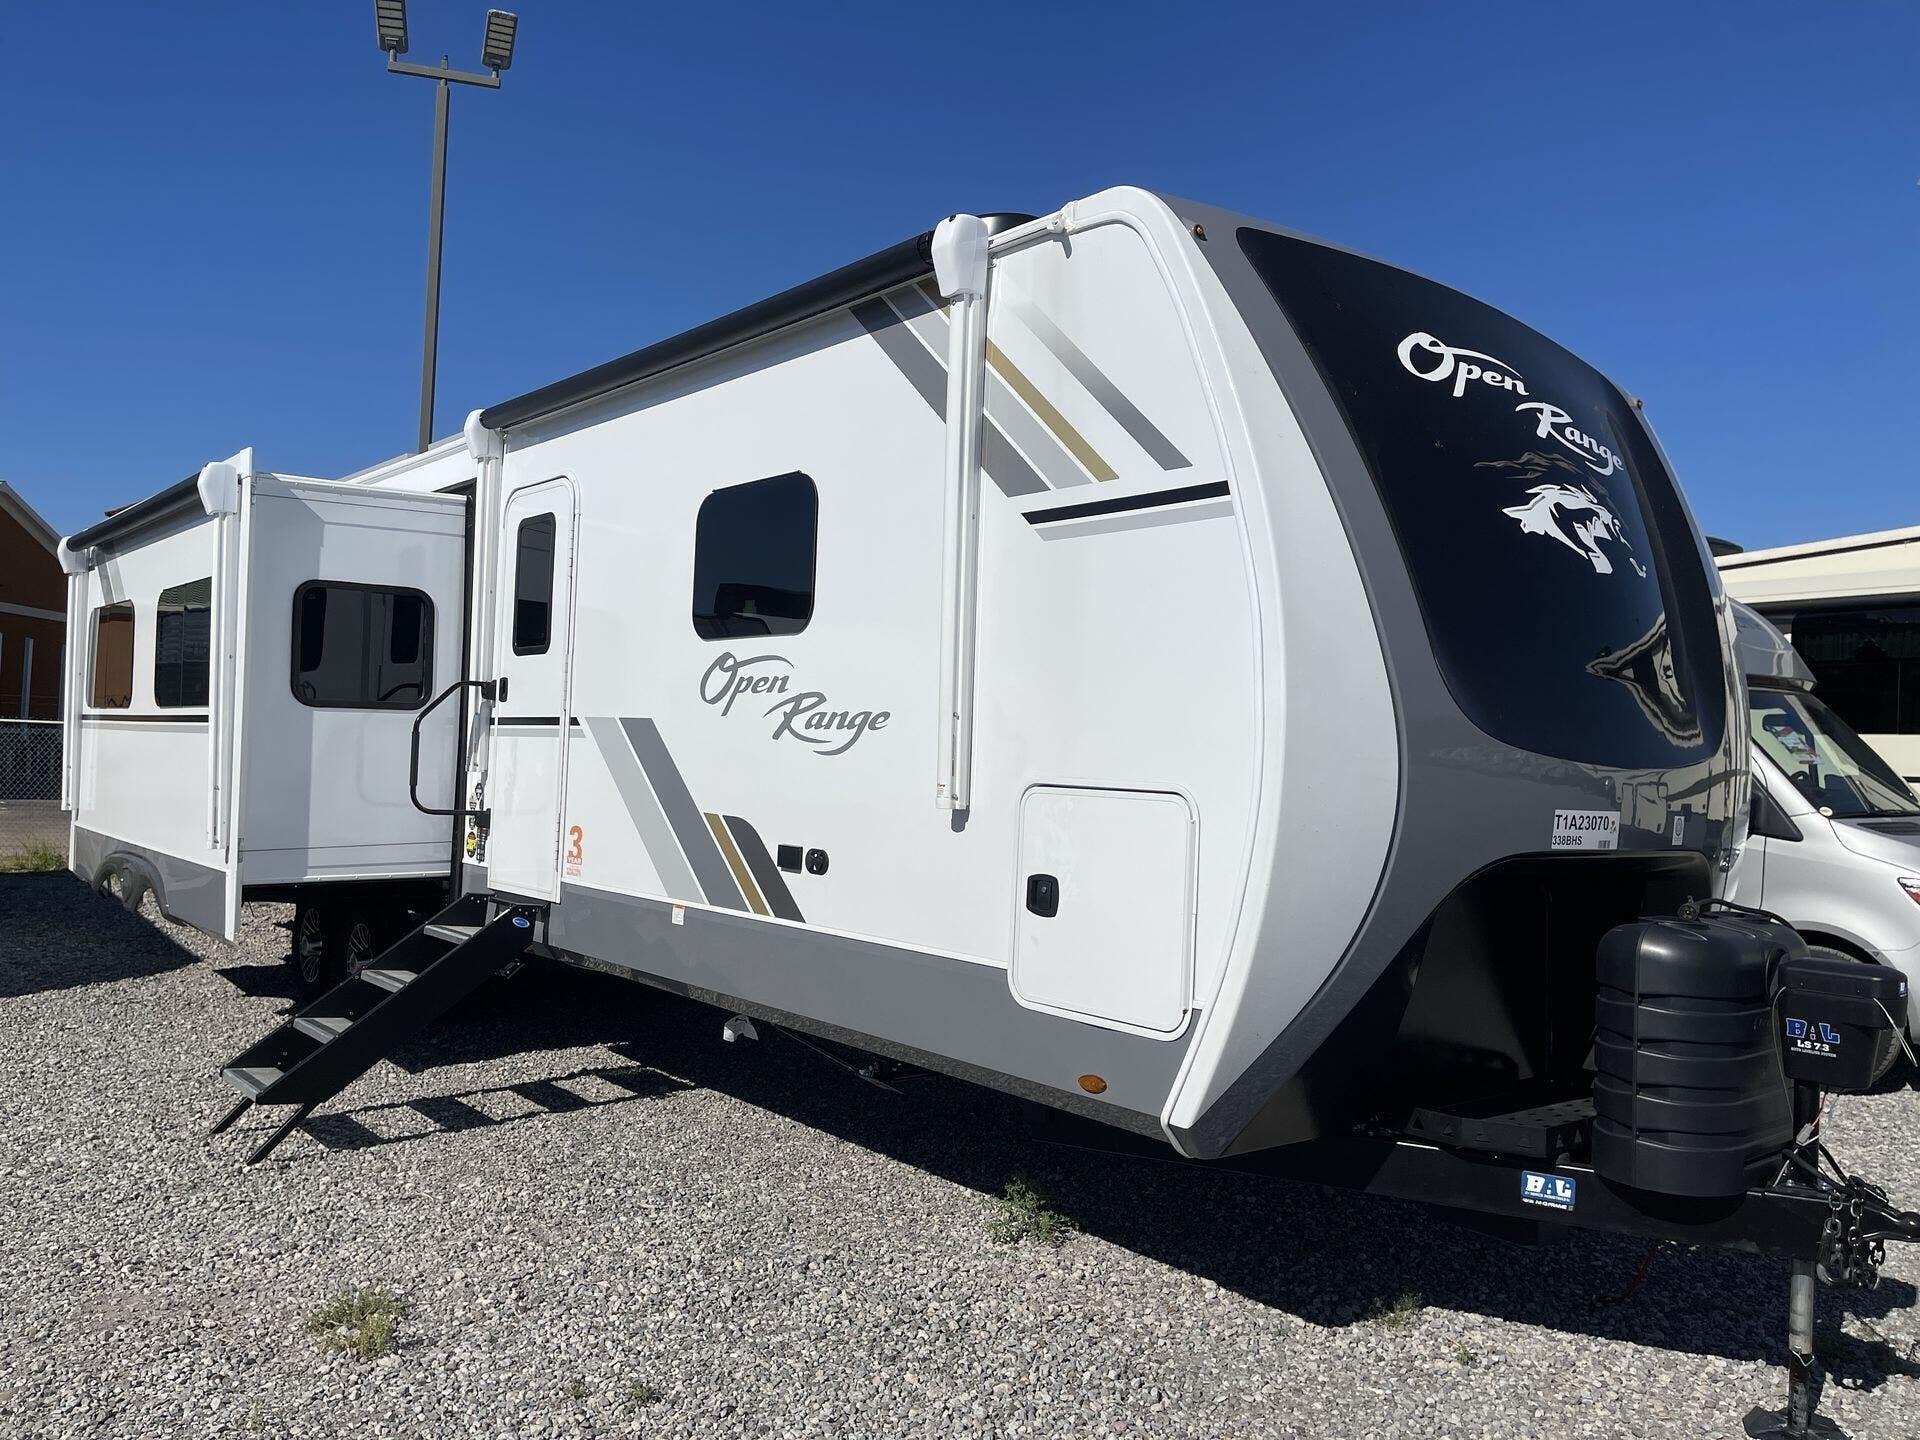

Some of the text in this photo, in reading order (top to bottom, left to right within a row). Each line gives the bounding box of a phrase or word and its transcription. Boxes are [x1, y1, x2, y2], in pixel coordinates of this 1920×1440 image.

[1397, 332, 1529, 397] Open
[1515, 402, 1624, 476] Range
[700, 652, 794, 716] Open
[763, 692, 890, 755] Range
[569, 825, 582, 858] 3
[1552, 835, 1582, 846] 338BHS
[1555, 814, 1610, 831] T1A23070
[1797, 1040, 1812, 1048] LS
